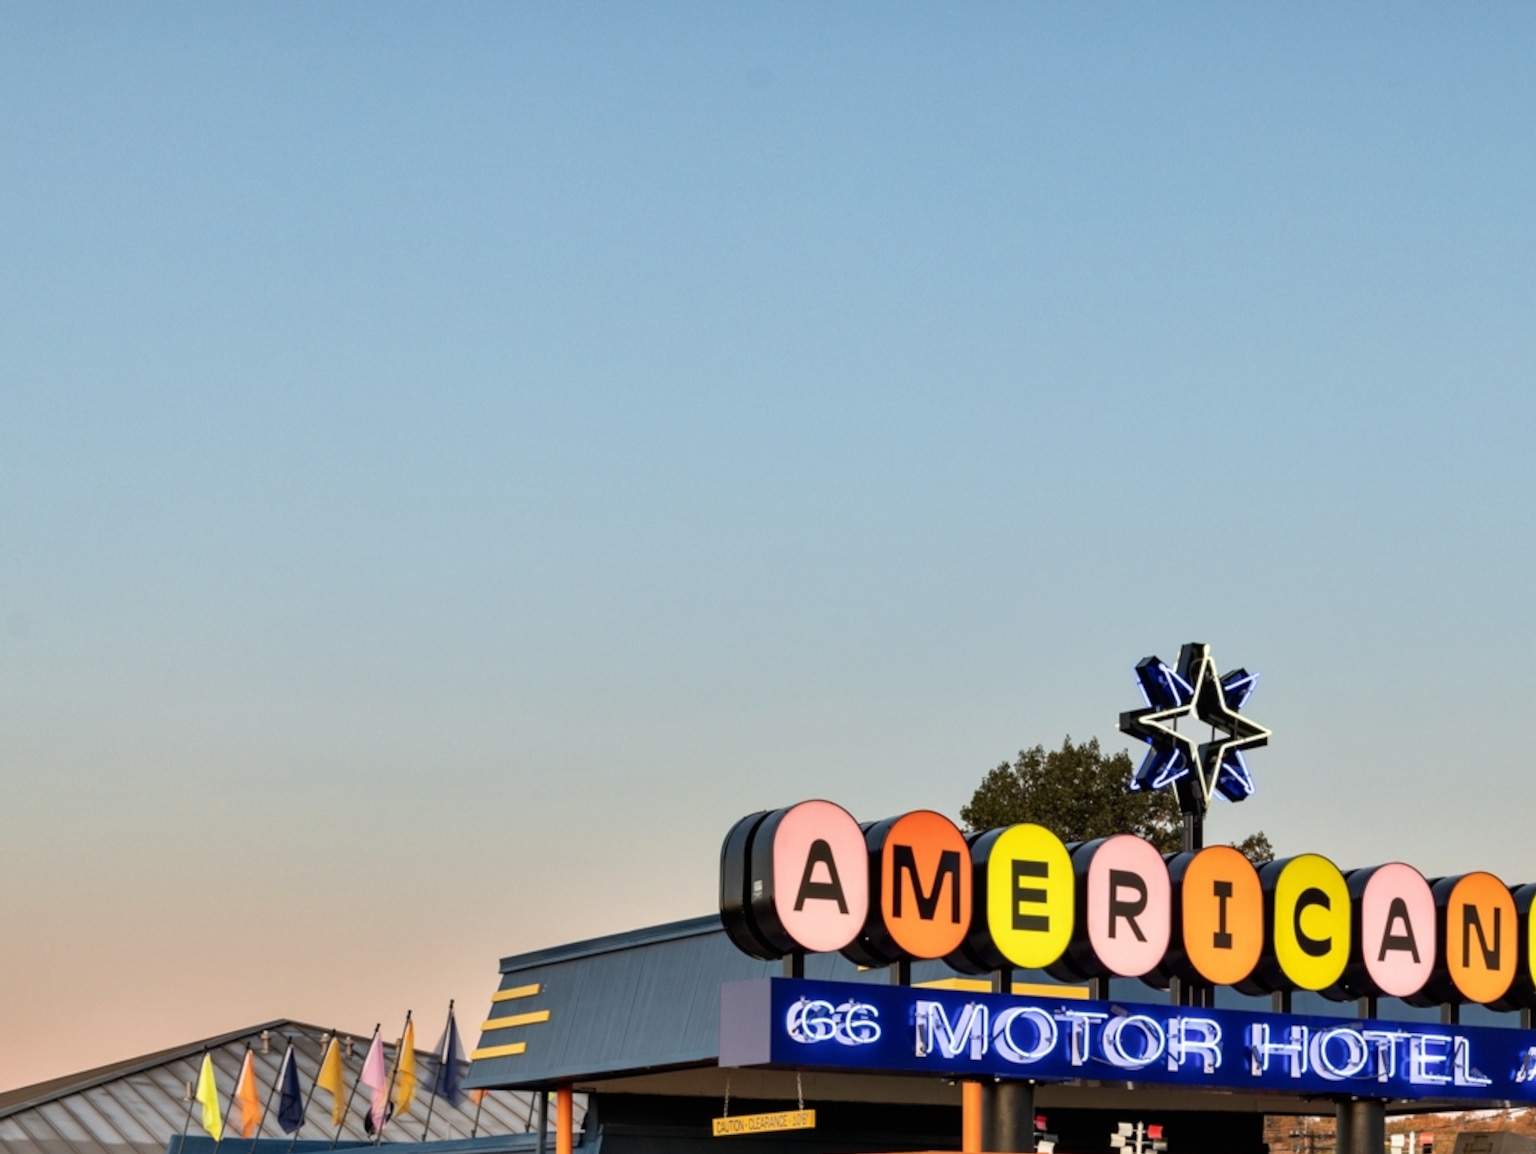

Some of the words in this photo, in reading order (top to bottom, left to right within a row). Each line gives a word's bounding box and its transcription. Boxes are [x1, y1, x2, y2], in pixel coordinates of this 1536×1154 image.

[785, 996, 882, 1046] 66
[914, 1000, 1222, 1074] MOTOR
[1251, 1022, 1492, 1088] HOTEL
